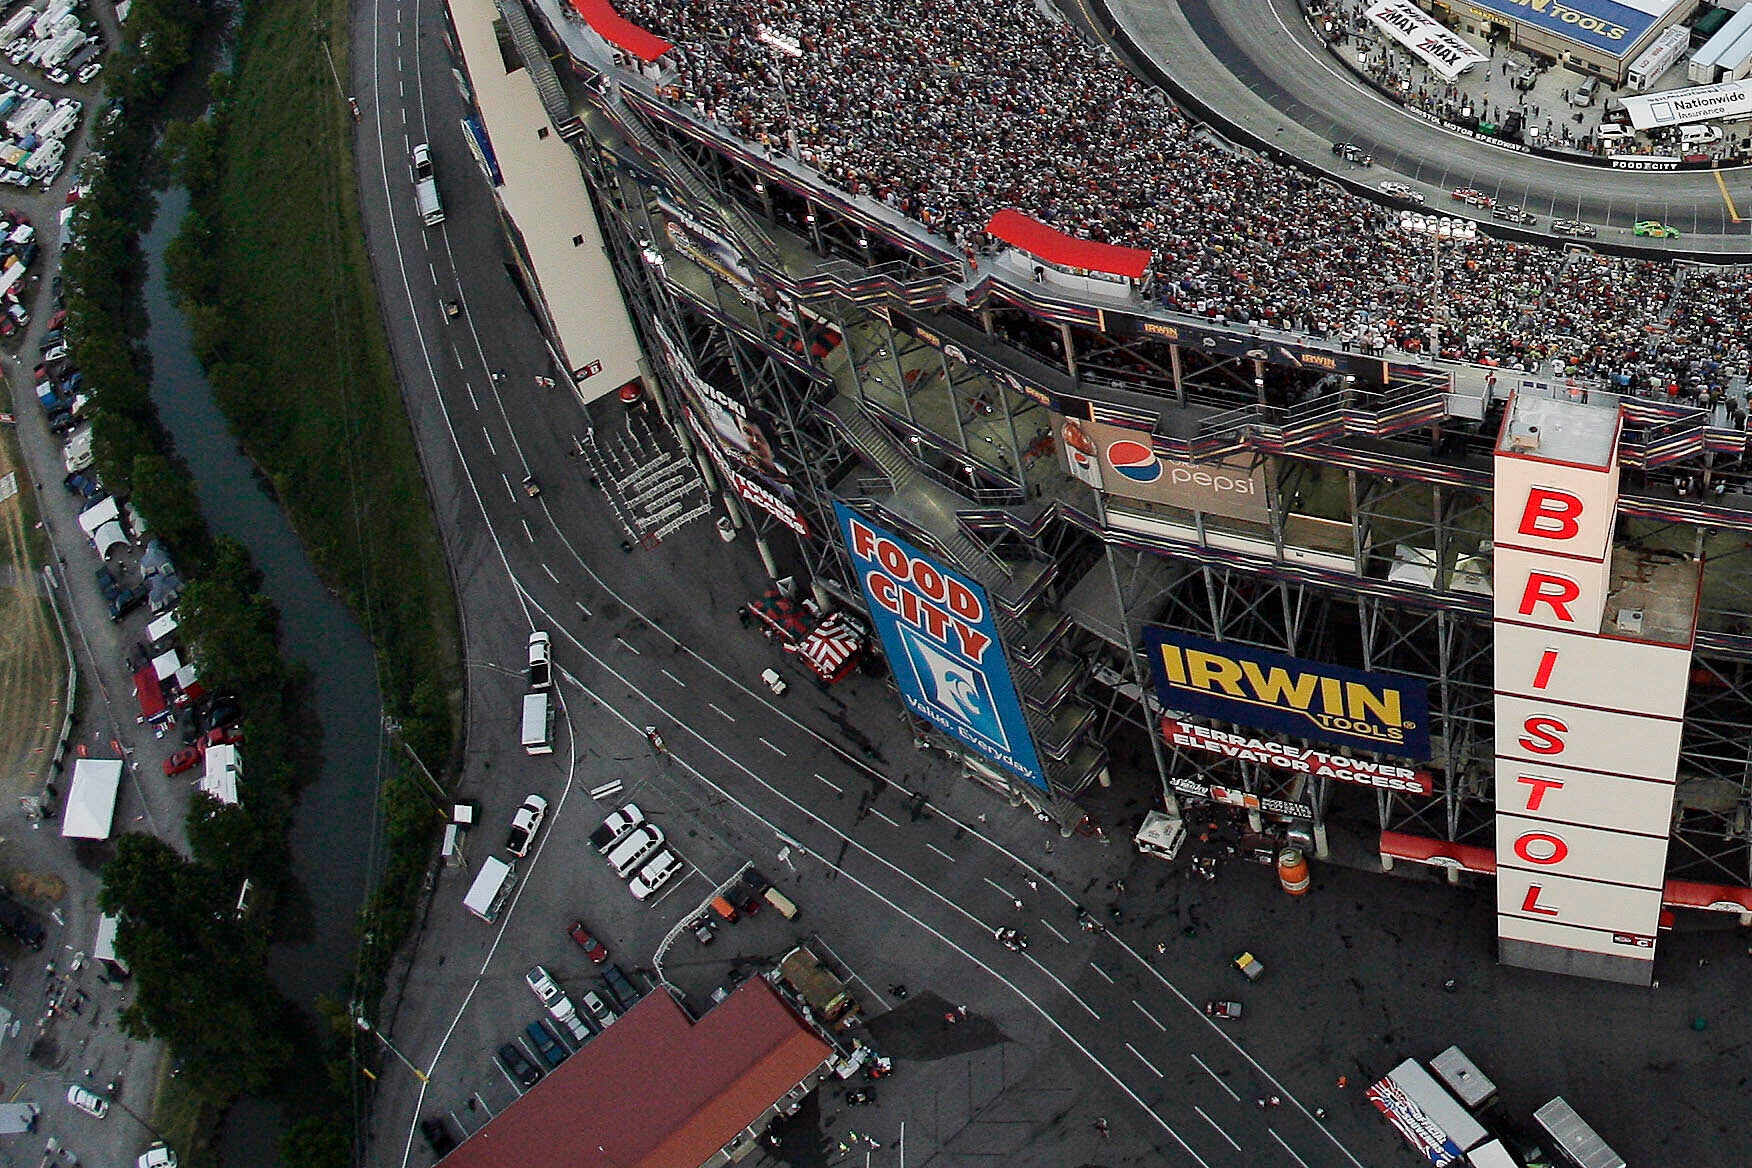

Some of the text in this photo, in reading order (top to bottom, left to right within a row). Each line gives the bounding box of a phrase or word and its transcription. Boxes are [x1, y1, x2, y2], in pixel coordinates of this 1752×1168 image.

[1549, 5, 1630, 42] TOOLS
[1673, 92, 1746, 111] Nationwide
[1678, 107, 1725, 120] Insurance
[1410, 106, 1522, 151] BRISTOL MOTOR SPEEDWAY
[1612, 160, 1678, 170] FOOD CITY
[1302, 354, 1336, 369] IRWIN
[1172, 468, 1254, 495] pepsi
[849, 518, 983, 624] FOOD
[867, 570, 992, 664] CITY
[1161, 643, 1404, 740] IRWIN TOOLS
[1513, 484, 1584, 917] BRISTOL
[907, 694, 1036, 781] Value. Everyday.
[1176, 721, 1416, 780] TERRACE/TOWER
[1173, 733, 1424, 793] ELEVATOR ACCESS
[1403, 1113, 1446, 1155] SOUVENIRS
[1413, 1109, 1448, 1145] OFFICIAL
